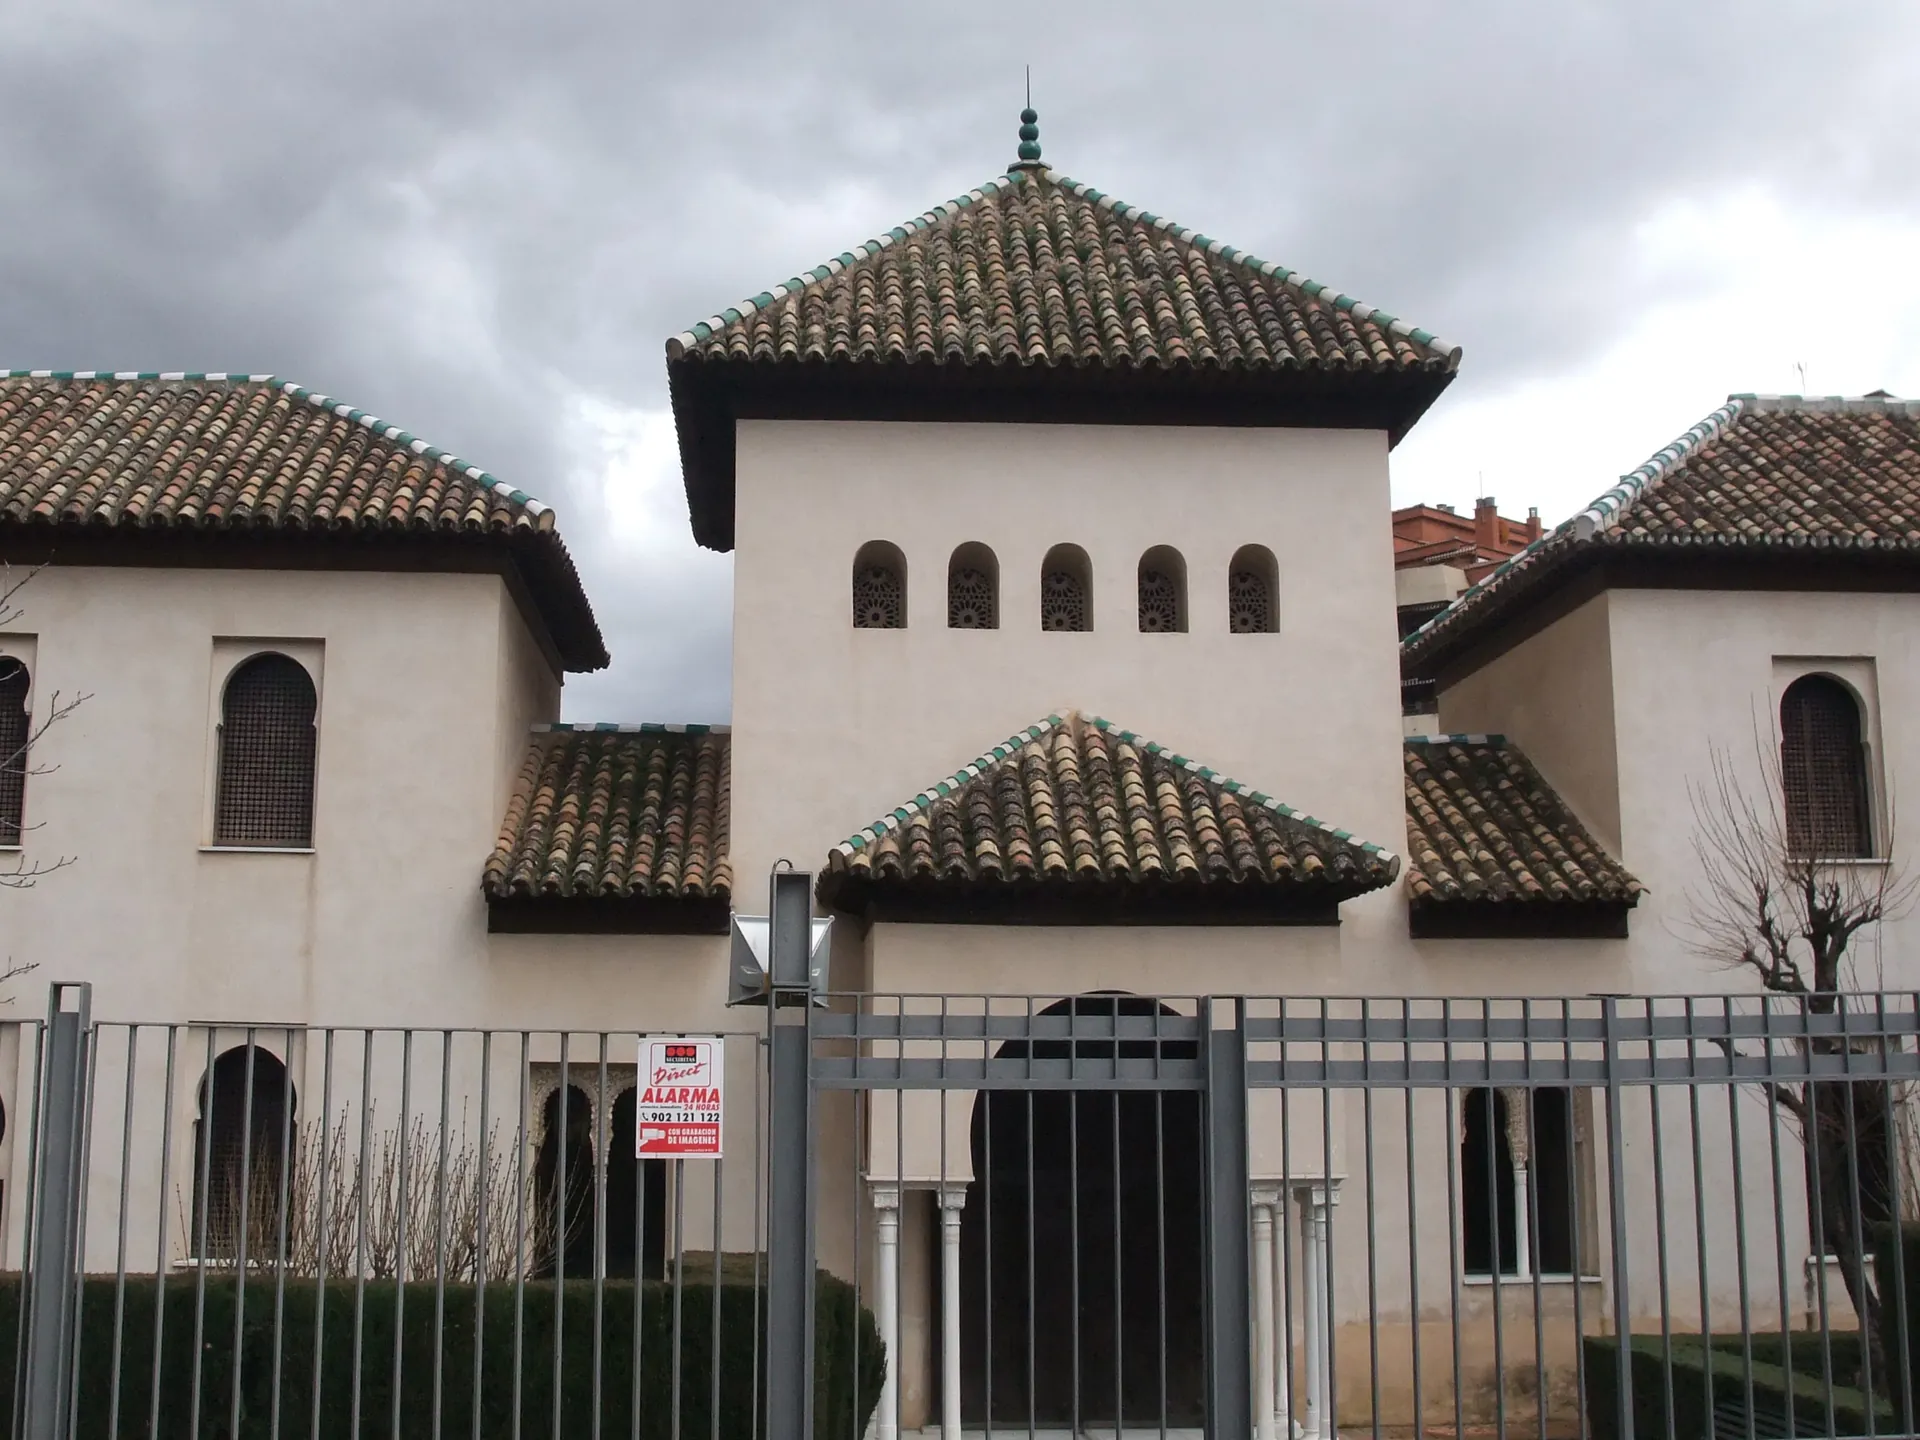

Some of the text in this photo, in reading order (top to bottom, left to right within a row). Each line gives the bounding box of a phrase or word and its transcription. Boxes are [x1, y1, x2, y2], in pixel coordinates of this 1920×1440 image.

[654, 1062, 707, 1085] Direct
[641, 1088, 720, 1103] ALARMA
[651, 1113, 720, 1122] 902 121 122
[668, 1136, 716, 1144] DE IMAGENES
